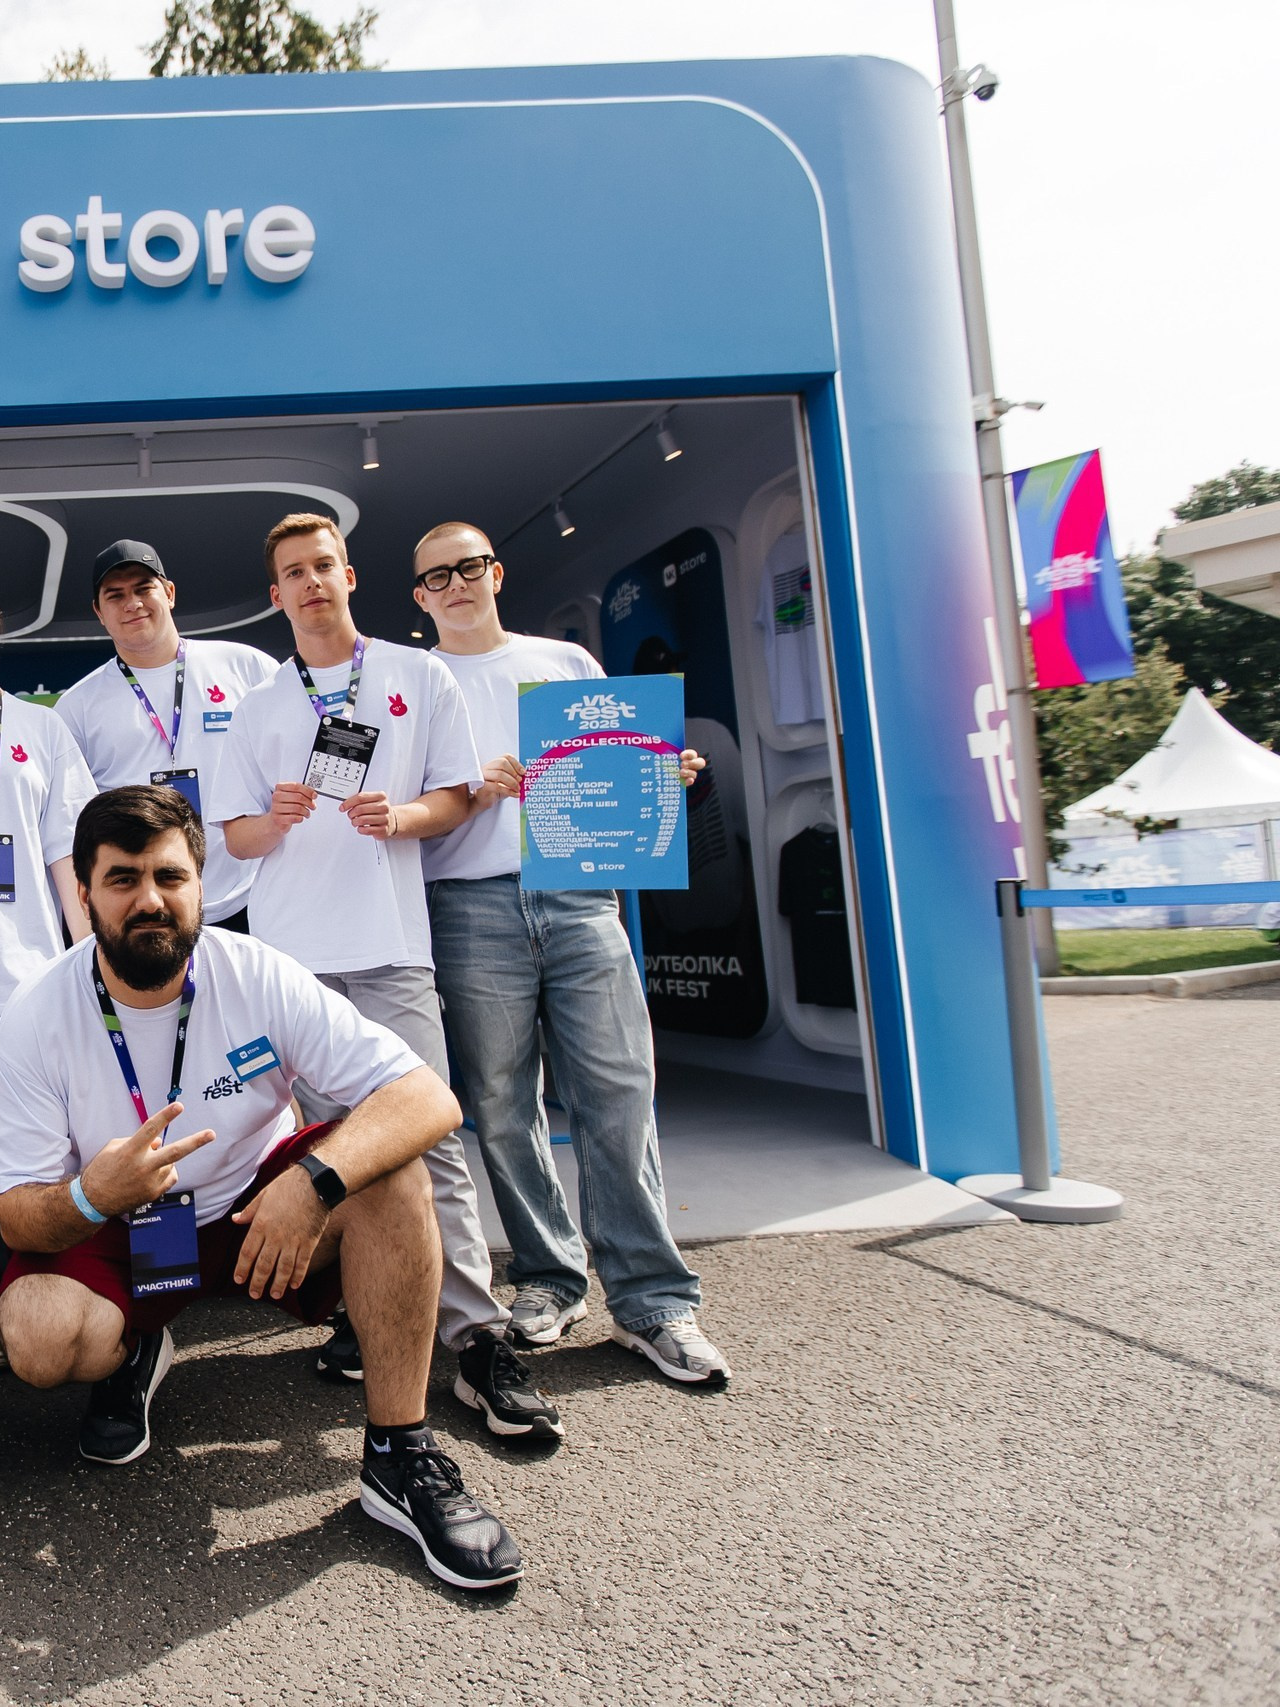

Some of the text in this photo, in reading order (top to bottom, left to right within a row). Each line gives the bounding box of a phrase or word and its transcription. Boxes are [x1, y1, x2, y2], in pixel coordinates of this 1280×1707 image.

[18, 195, 316, 292] store
[582, 694, 618, 706] VK
[563, 701, 637, 721] fest
[578, 719, 620, 730] 2025
[540, 735, 662, 749] VK COLLECTIONS
[525, 763, 583, 771] ЛОНГСЛИВЫ
[524, 776, 577, 784] ДОЖДЕВИК
[524, 788, 607, 796] РЮКЗАКИ/СУМКИ
[595, 800, 618, 808] ШЕИ
[598, 862, 625, 871] store
[666, 979, 710, 998] FEST
[214, 1074, 233, 1087] VK
[202, 1080, 244, 1101] fest
[132, 1216, 162, 1225] МОСКВА
[137, 1277, 194, 1292] УЧАСТНИК
